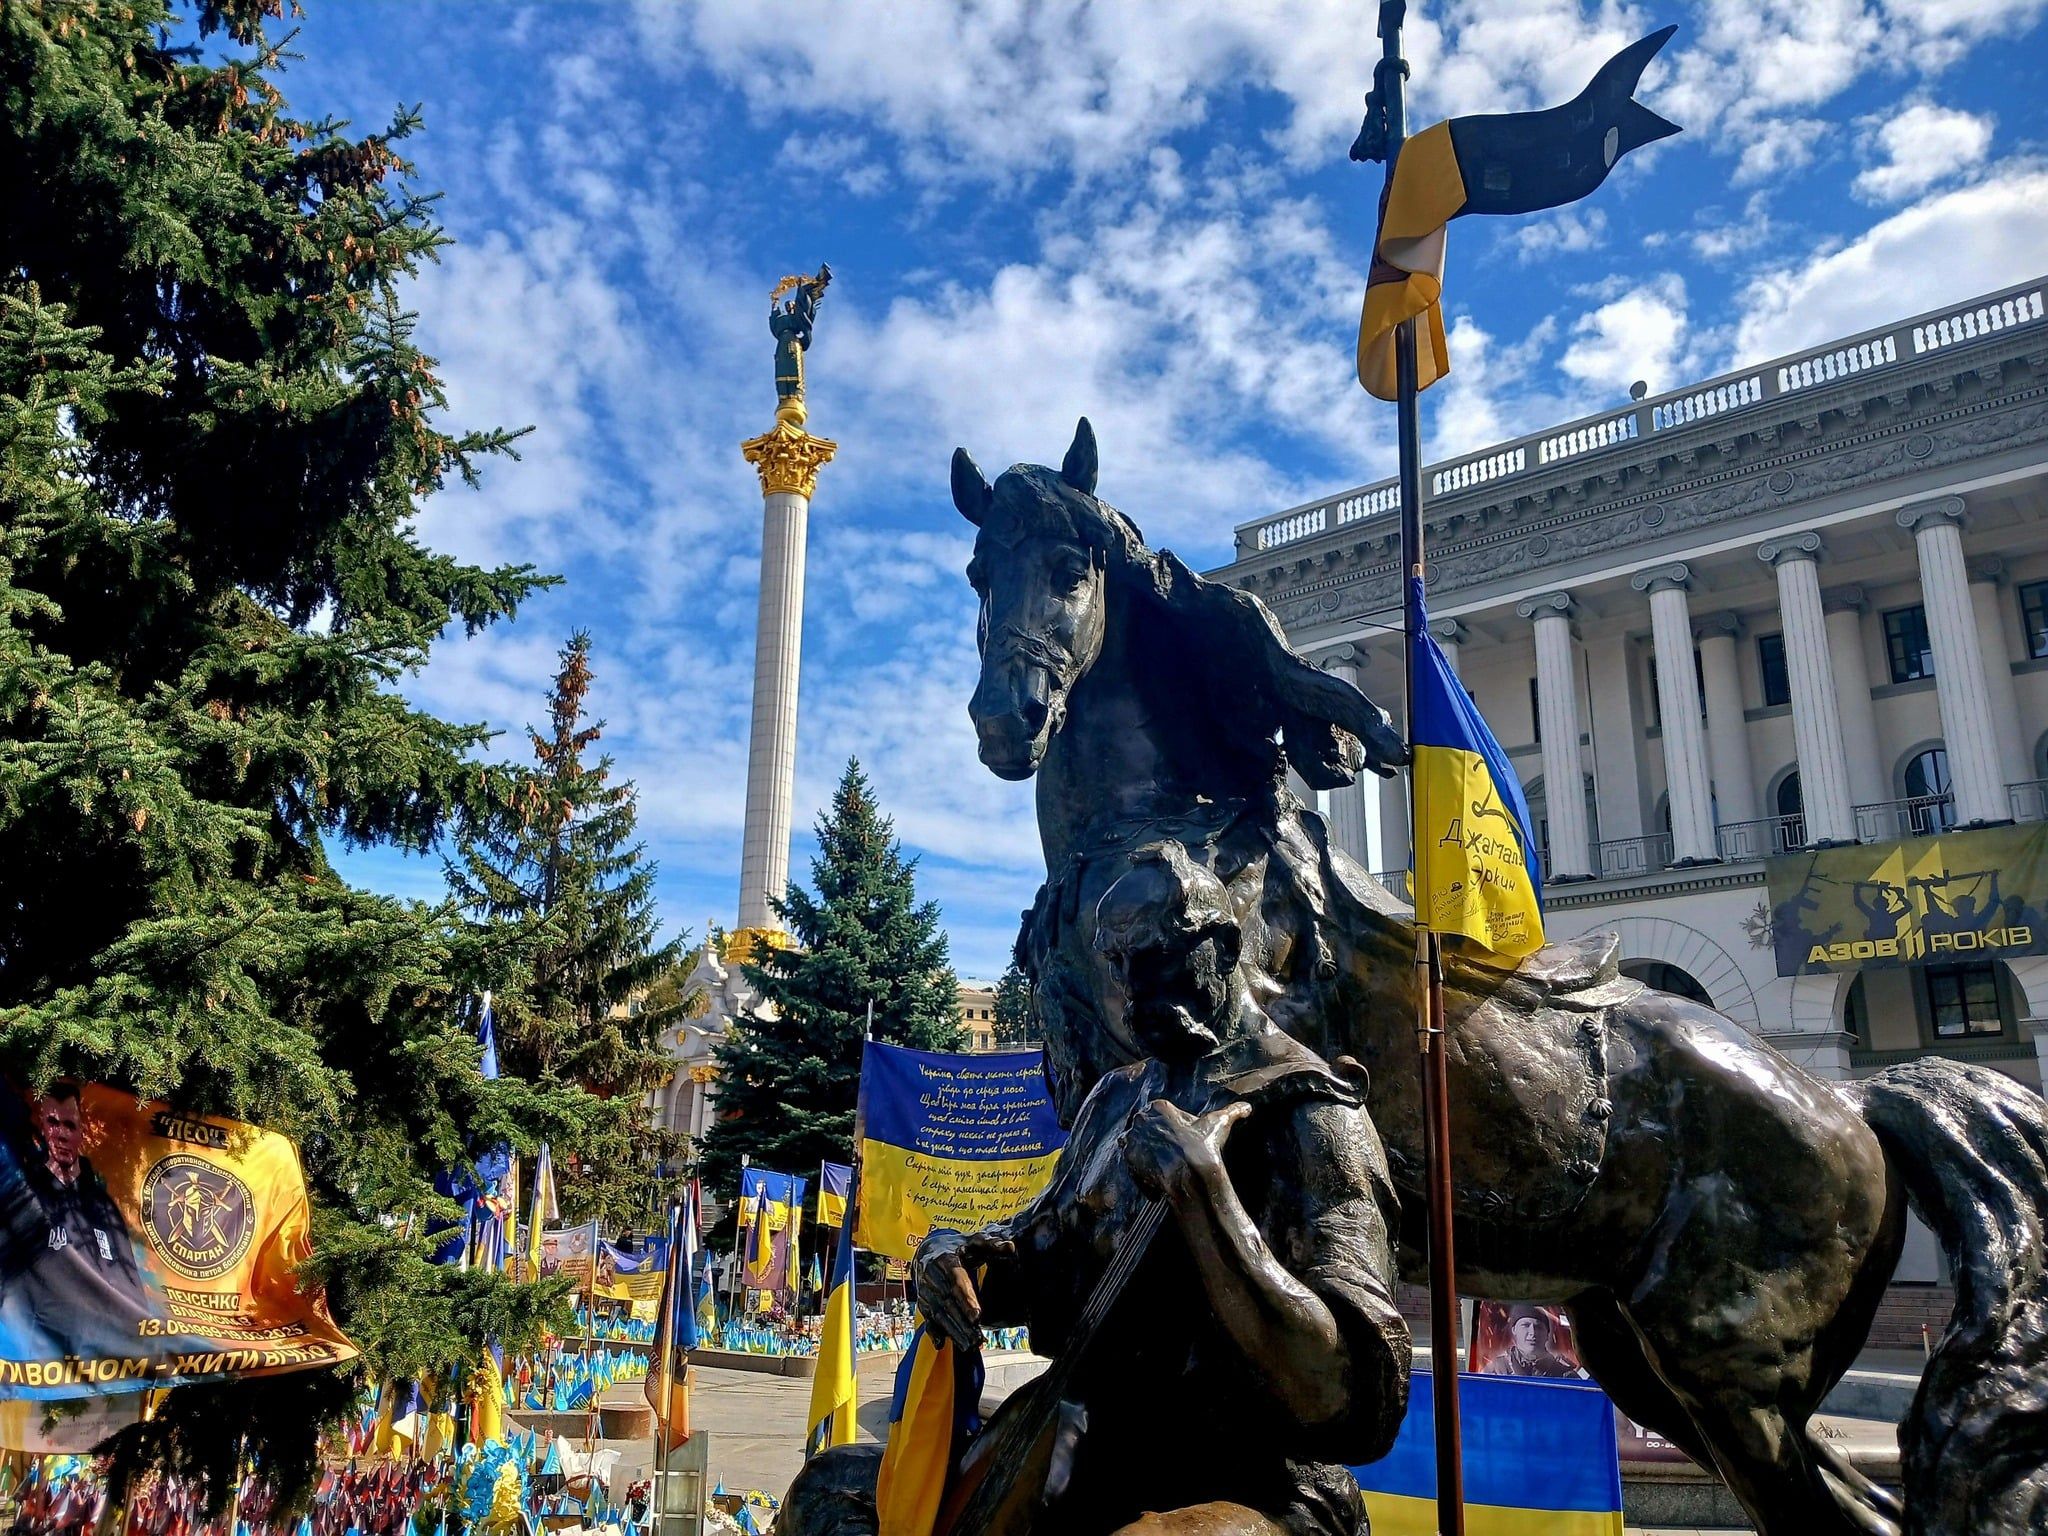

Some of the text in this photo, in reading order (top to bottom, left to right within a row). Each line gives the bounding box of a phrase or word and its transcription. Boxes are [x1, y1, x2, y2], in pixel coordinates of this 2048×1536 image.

[1807, 926, 2033, 963] АЗОВ 11 РОКІВ
[963, 1088, 973, 1099] до
[172, 1242, 225, 1261] СПАРТАН
[199, 1267, 223, 1278] петра
[170, 1304, 250, 1327] ВЛАДИСЛАВ
[26, 1355, 149, 1386] ВОЇНОМ
[171, 1350, 259, 1376] ЖИТИ
[264, 1344, 329, 1367] ВІЧНО
